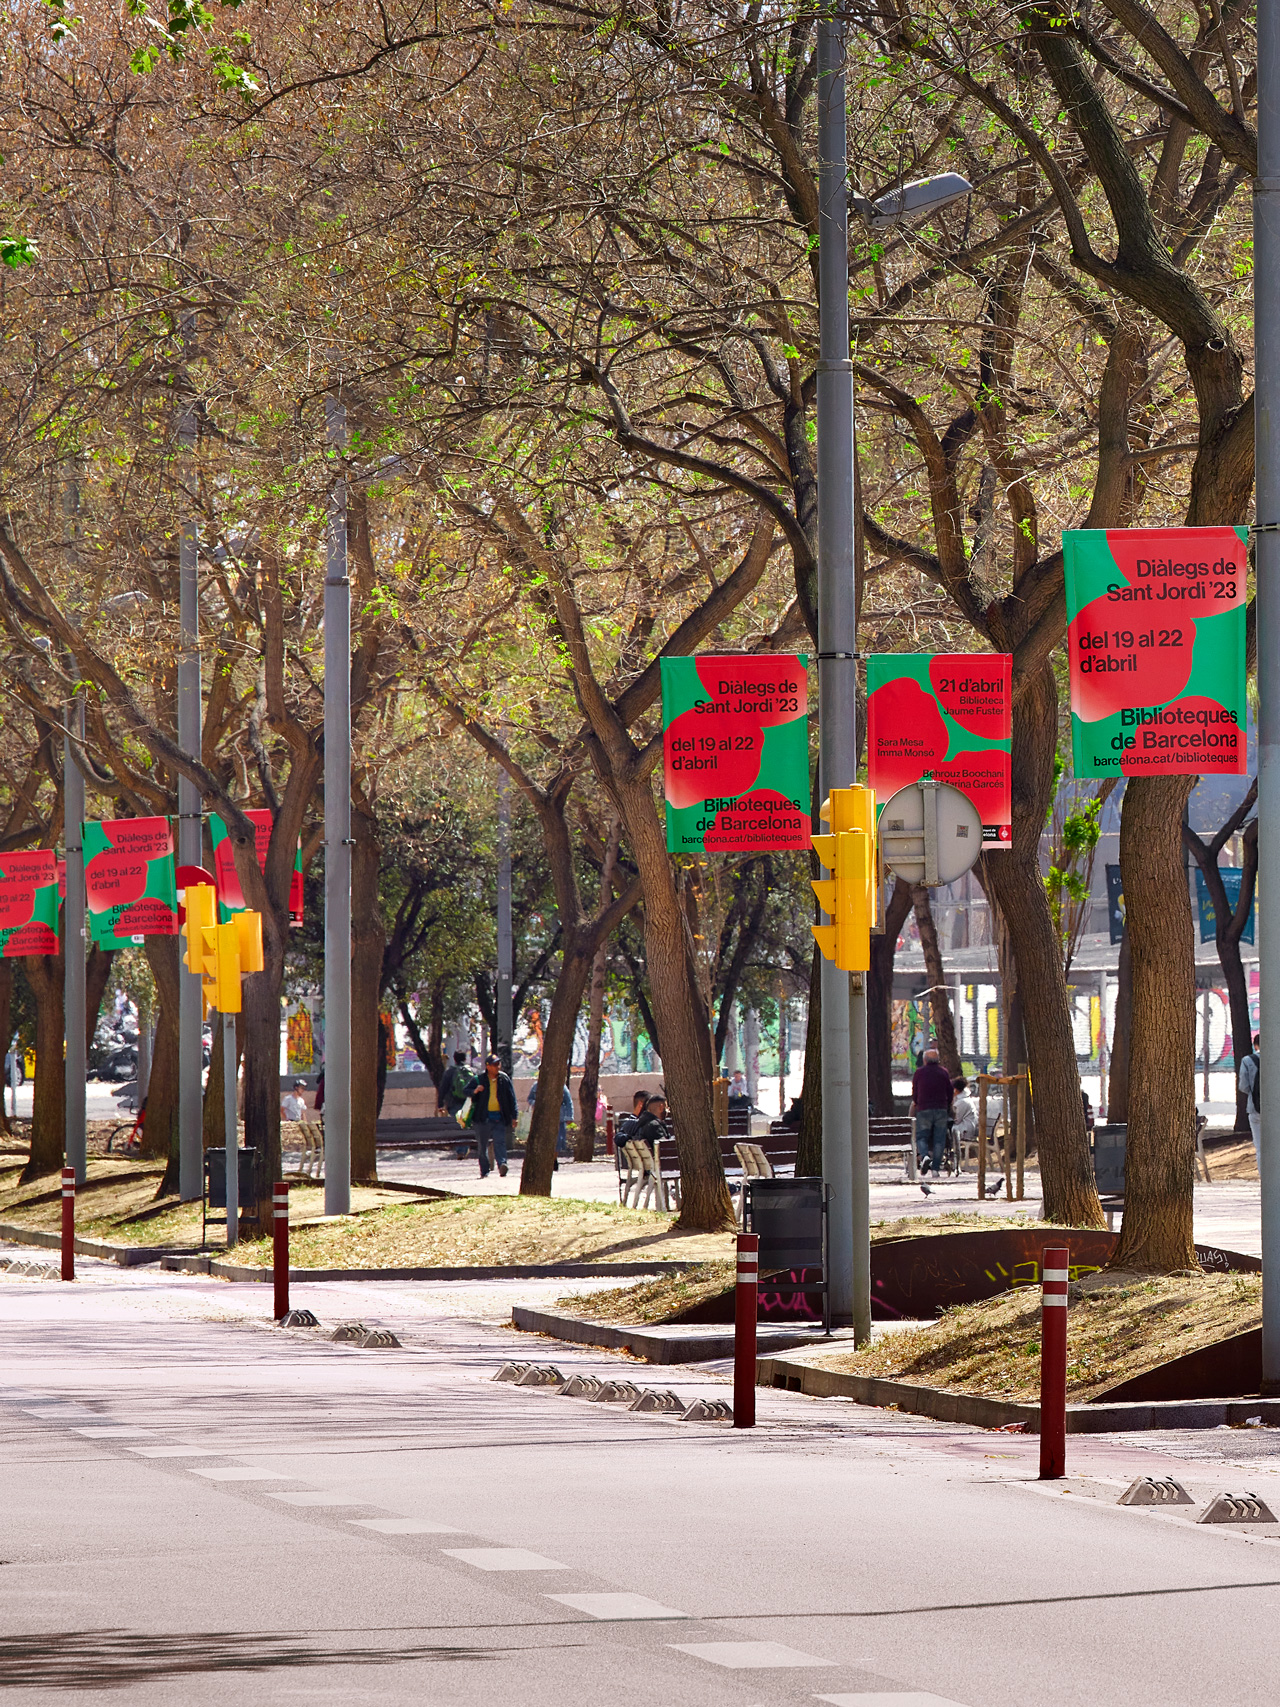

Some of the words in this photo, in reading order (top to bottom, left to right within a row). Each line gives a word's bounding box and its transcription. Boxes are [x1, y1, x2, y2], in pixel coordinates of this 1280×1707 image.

[1137, 559, 1209, 579] Diàlegs
[1212, 558, 1237, 576] de
[1106, 584, 1153, 602] Sant
[1156, 582, 1206, 600] Jordi
[1079, 631, 1108, 649] del
[1112, 631, 1134, 648] 19
[1138, 630, 1154, 648] al
[1158, 630, 1183, 647] 22
[718, 680, 775, 697] Diàlegs
[779, 679, 797, 693] de
[939, 679, 956, 692] 21
[694, 700, 730, 714] Sant
[734, 699, 773, 713] Jordi
[960, 697, 1004, 705] Biblioteca
[944, 707, 974, 715] Jaume
[976, 707, 1004, 715] Fuster
[1121, 708, 1238, 727] Biblioteques
[672, 737, 695, 751] del
[699, 737, 716, 751] 19
[719, 737, 731, 750] al
[735, 737, 754, 750] 22
[877, 738, 898, 746] Sara
[900, 738, 923, 746] Mesa
[1111, 733, 1136, 750] de
[1143, 730, 1237, 749] Barcelona
[877, 749, 902, 757] Imma
[904, 748, 934, 757] Monsó
[1094, 753, 1238, 766] barcelona.cat/biblioteques
[923, 770, 960, 778] Behrouz
[962, 770, 1004, 778] Boochani
[973, 779, 1004, 788] Garcés
[704, 798, 801, 813] Biblioteques
[696, 817, 716, 831] de
[722, 817, 801, 830] Barcelona
[117, 834, 153, 843] Diàlegs
[155, 832, 167, 840] de
[682, 834, 802, 844] barcelona.cat/biblioteques
[103, 846, 125, 855] Sant
[128, 844, 152, 853] Jordi
[91, 870, 105, 879] del
[108, 869, 117, 877] 19
[120, 868, 127, 876] al
[129, 867, 141, 875] 22
[113, 903, 172, 913] Biblioteques
[108, 917, 120, 925] de
[124, 914, 172, 923] Barcelona
